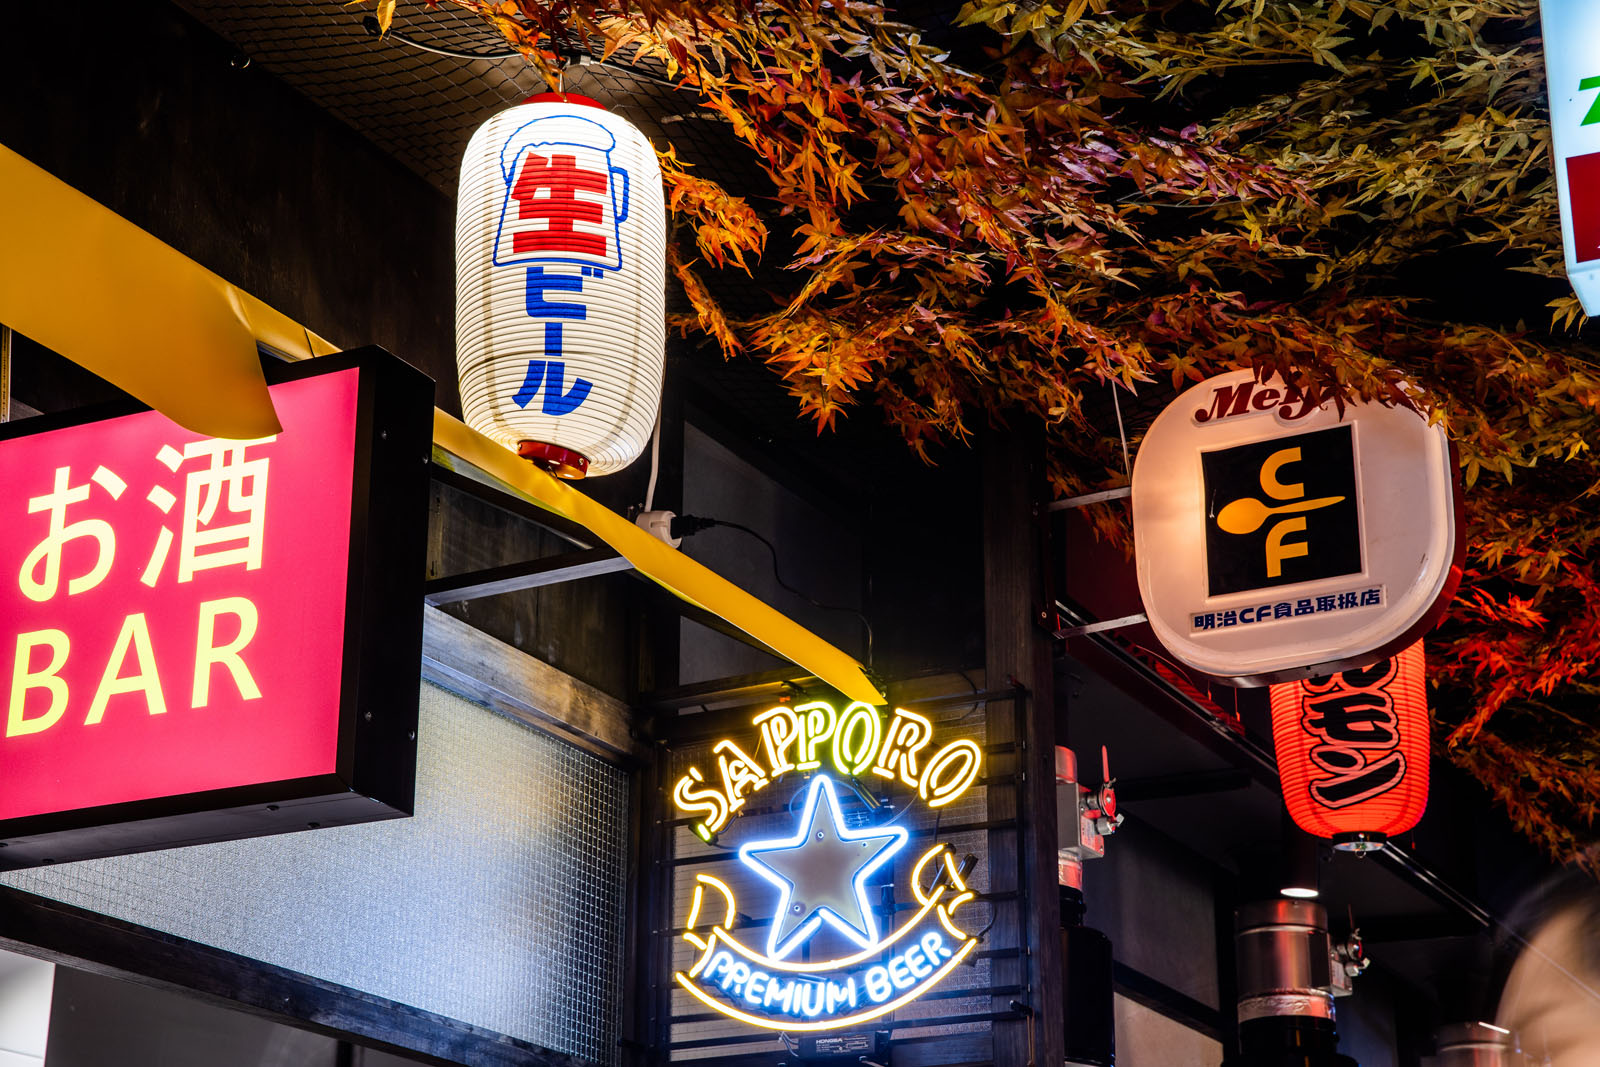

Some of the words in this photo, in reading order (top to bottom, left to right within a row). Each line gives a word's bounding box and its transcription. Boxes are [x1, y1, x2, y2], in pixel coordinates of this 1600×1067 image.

[510, 152, 608, 416] 生ビール
[18, 434, 278, 602] お酒
[5, 596, 263, 738] BAR
[1194, 589, 1381, 630] 明治CF食品取扱店
[674, 701, 982, 841] SAPPORO
[702, 950, 857, 1017] PREMIUM
[863, 930, 953, 1004] BEER
